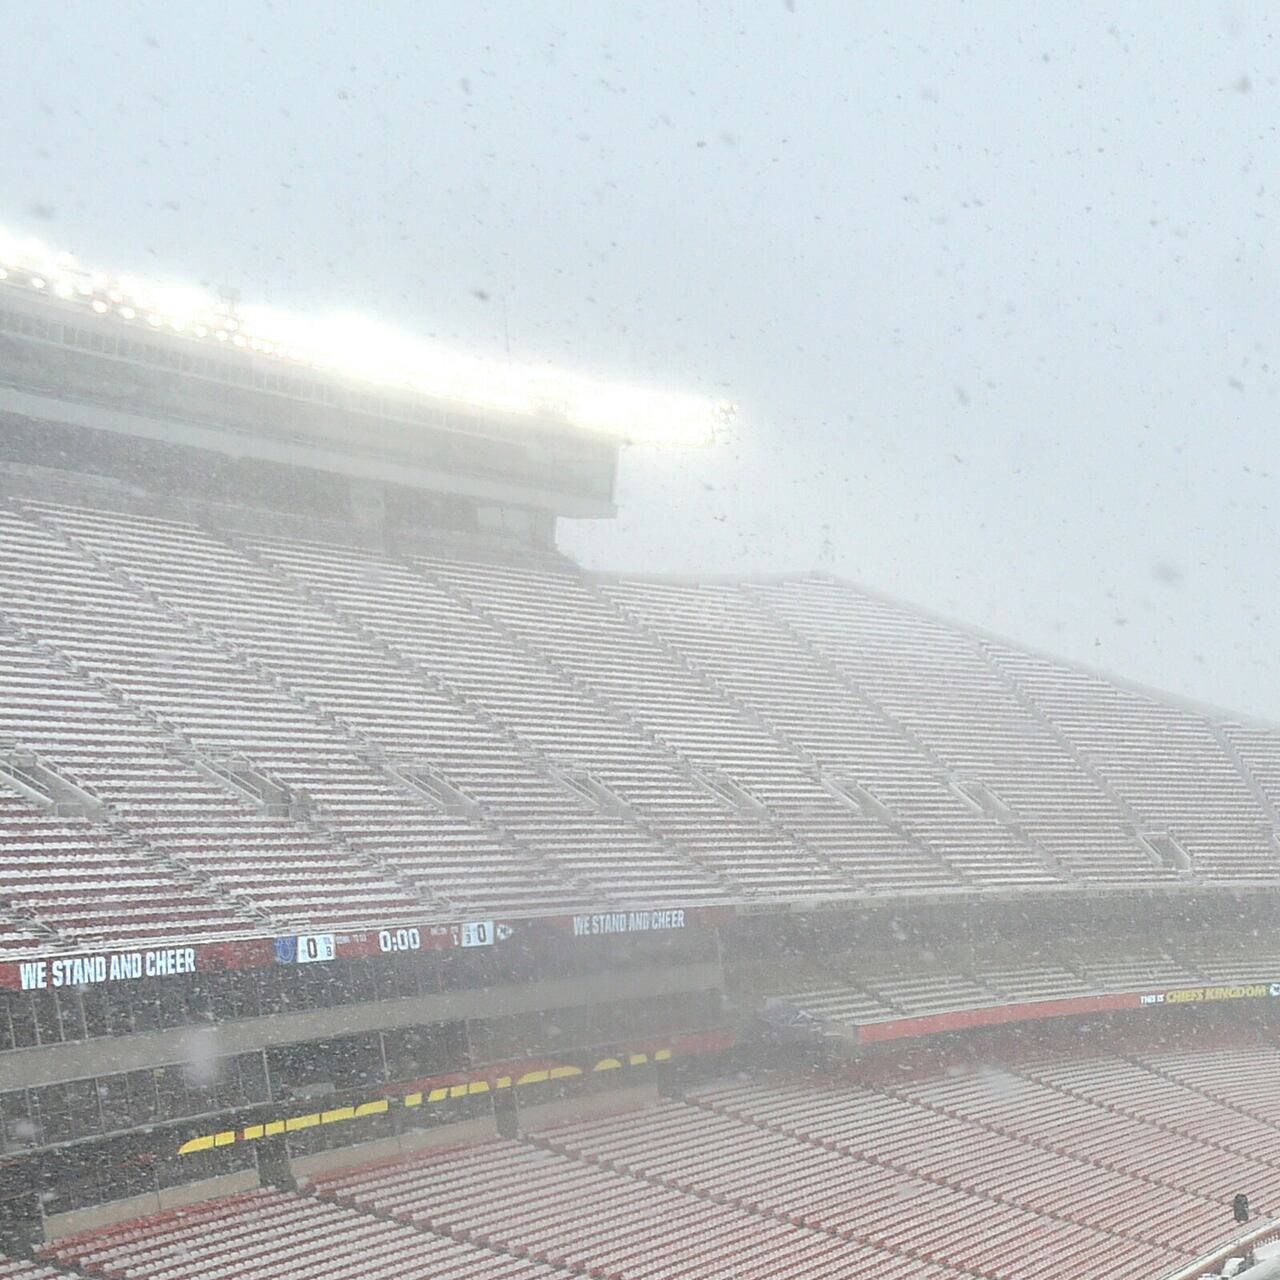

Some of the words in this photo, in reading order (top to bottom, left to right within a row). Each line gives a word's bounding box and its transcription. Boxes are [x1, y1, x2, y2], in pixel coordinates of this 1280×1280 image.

[477, 924, 486, 943] 0
[573, 915, 590, 936] WE
[592, 913, 626, 934] STAND
[628, 911, 649, 931] AND
[652, 910, 685, 929] CHEER
[307, 937, 317, 959] 0
[379, 928, 421, 951] 0:00
[20, 962, 47, 990] WE
[52, 956, 106, 987] STAND
[110, 953, 142, 981] AND
[146, 948, 196, 977] CHEER
[1167, 990, 1203, 1003] CHIEFS
[1205, 985, 1267, 1000] KINGDOM
